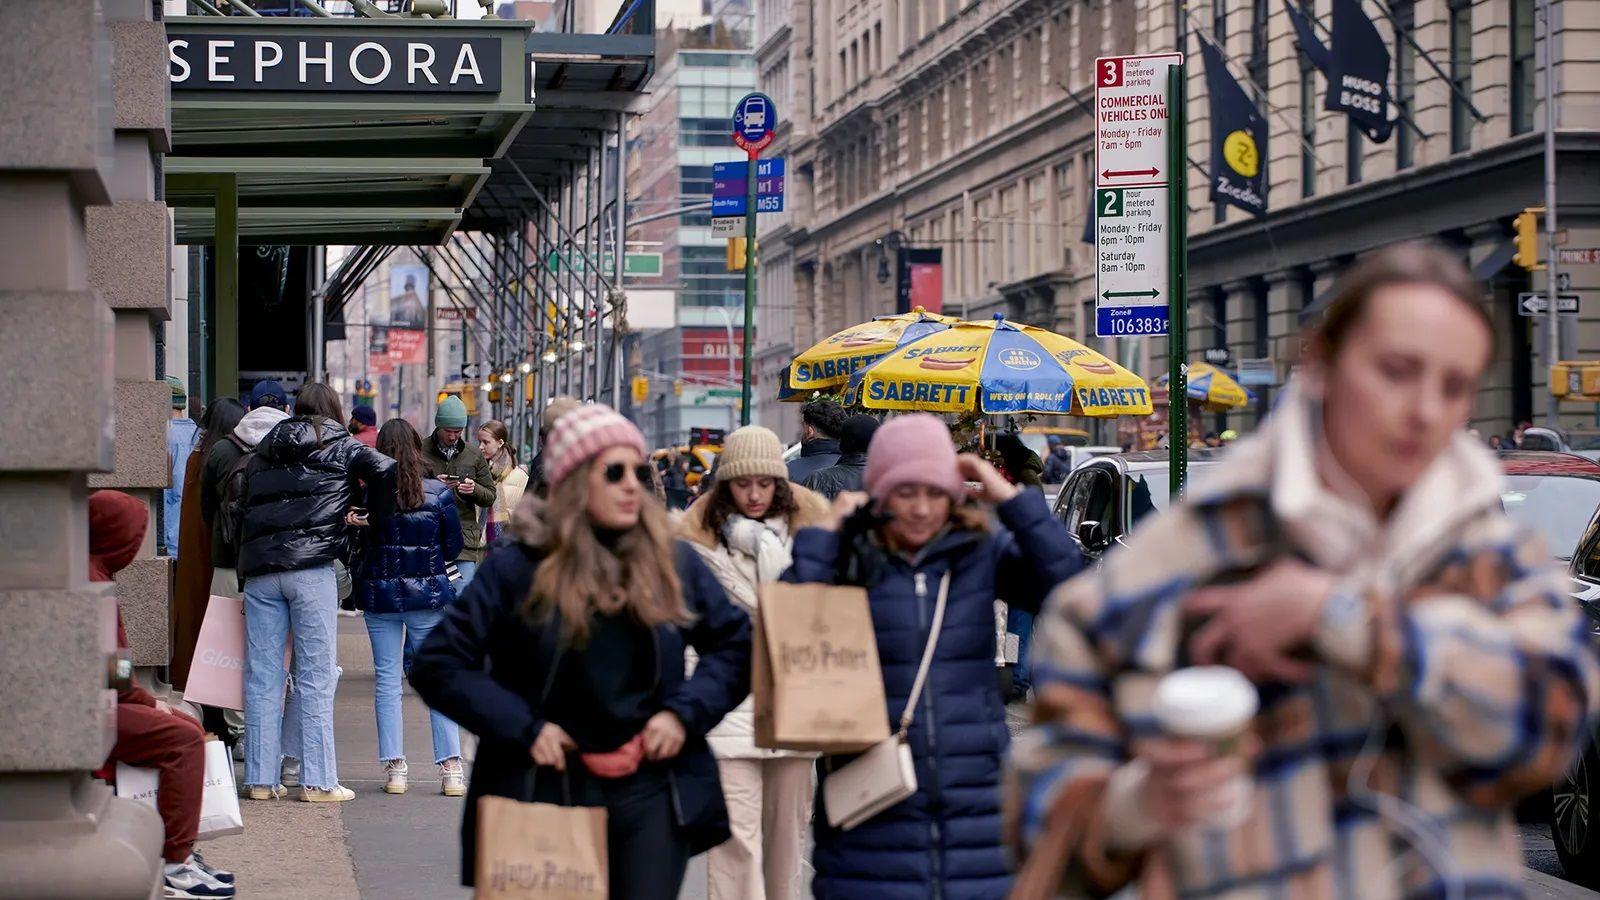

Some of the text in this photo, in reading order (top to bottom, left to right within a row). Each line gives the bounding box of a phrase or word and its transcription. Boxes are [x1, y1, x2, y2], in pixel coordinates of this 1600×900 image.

[168, 39, 484, 85] SEPHORA
[1125, 60, 1141, 68] hour
[1103, 61, 1117, 85] 3
[1125, 68, 1154, 77] metered
[1125, 79, 1151, 88] parking
[1342, 74, 1382, 96] HUGO
[1101, 95, 1164, 108] COMMERCIAL
[1340, 90, 1380, 114] BOSS
[1101, 108, 1169, 122] VEHICLES ONL
[1101, 128, 1130, 139] Monday
[1138, 127, 1162, 138] Friday
[1101, 141, 1117, 150] 7am
[1125, 140, 1142, 149] 6pm
[758, 161, 771, 175] M1
[758, 180, 771, 193] M1
[1125, 190, 1141, 198] hour
[757, 196, 779, 210] M55
[1104, 191, 1117, 215] 2
[1125, 199, 1155, 207] metered
[1125, 208, 1151, 217] parking
[1100, 224, 1131, 235] Monday
[1138, 223, 1162, 233] Friday
[1100, 236, 1118, 246] 6pm
[1124, 235, 1145, 245] 10pm
[1100, 252, 1136, 262] Saturday
[1101, 263, 1118, 273] 8am
[1125, 262, 1145, 272] 10pm
[1110, 309, 1132, 317] Zone#
[1111, 317, 1161, 334] 106383
[796, 353, 886, 382] SABRET
[869, 380, 971, 405] SABRETT
[1034, 391, 1052, 401] ROLL
[1079, 387, 1148, 407] SABRETT
[199, 648, 245, 670] Glos
